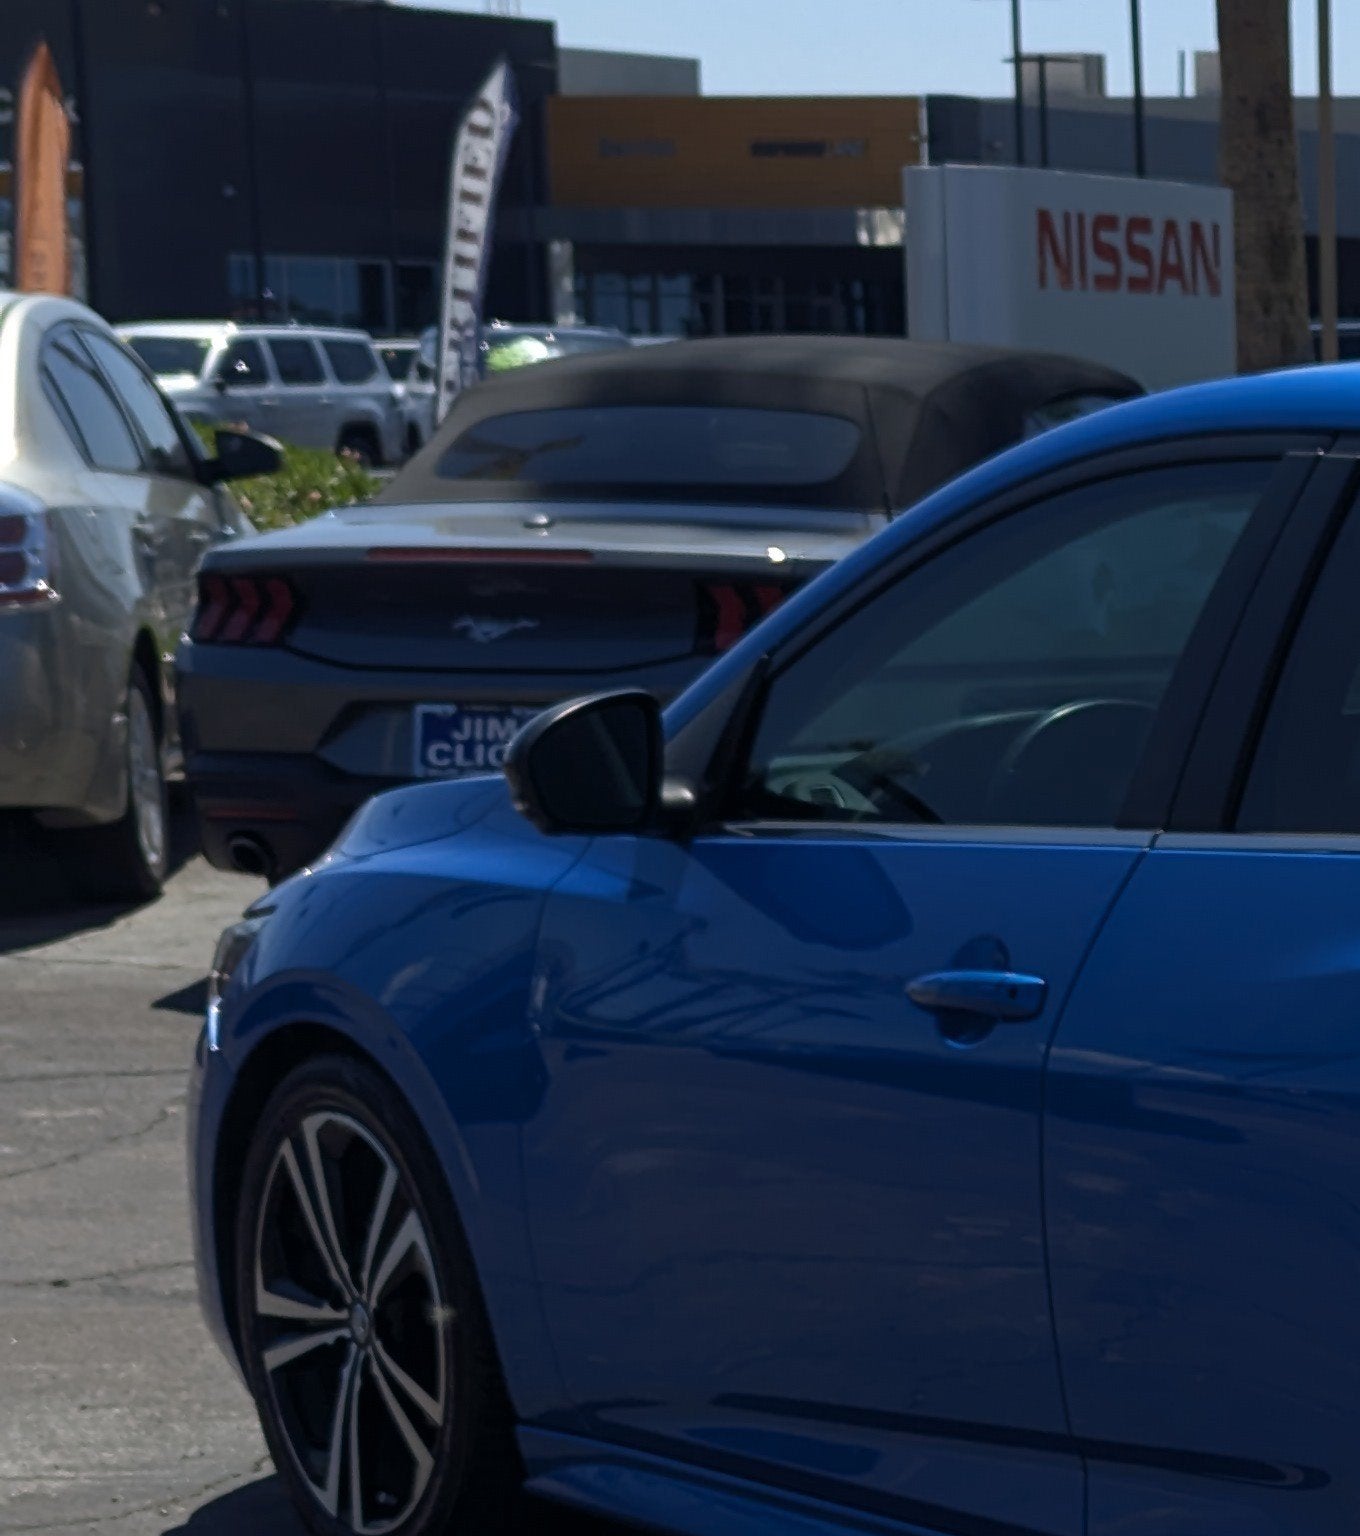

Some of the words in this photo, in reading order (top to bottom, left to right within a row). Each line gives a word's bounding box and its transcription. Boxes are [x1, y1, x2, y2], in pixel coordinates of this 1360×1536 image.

[444, 97, 494, 393] RTIFIED
[1037, 208, 1222, 297] NISSAN
[426, 742, 508, 767] CLIC
[451, 717, 518, 742] JIM
